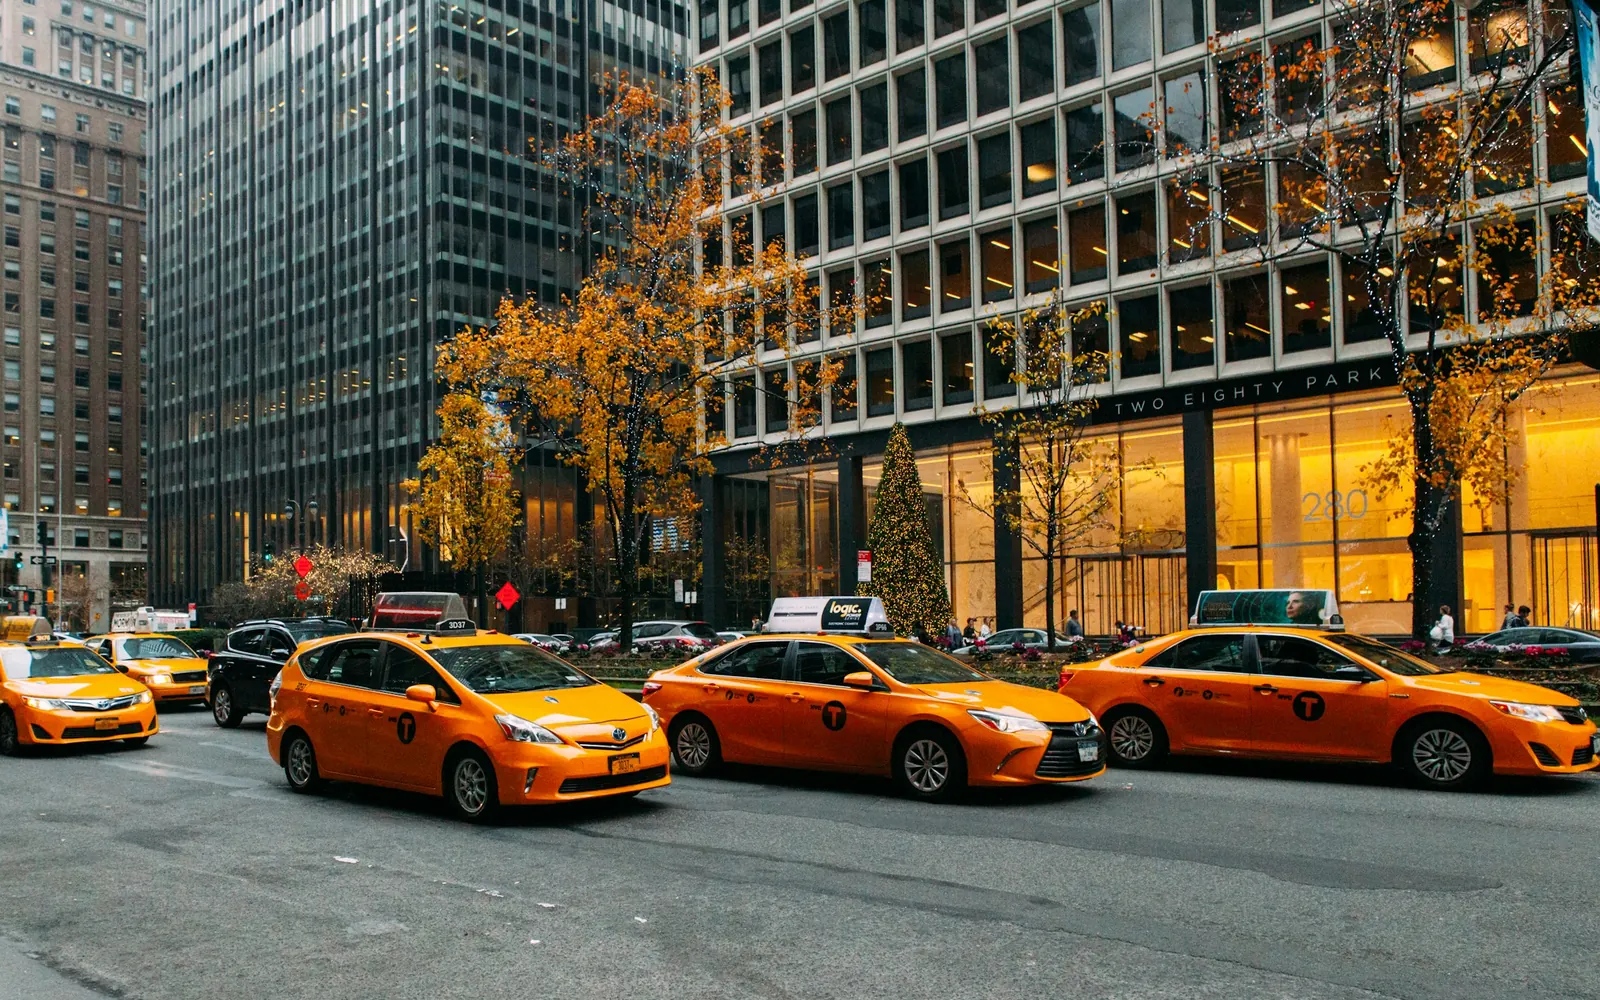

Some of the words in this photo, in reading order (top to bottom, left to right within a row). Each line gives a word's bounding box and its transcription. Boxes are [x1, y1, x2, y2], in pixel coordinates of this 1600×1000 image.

[1115, 398, 1164, 415] TWO
[1184, 380, 1283, 406] EIGHTY
[1306, 367, 1381, 389] PARK
[1302, 488, 1368, 521] 280
[449, 621, 466, 629] 3D37
[828, 705, 841, 727] T
[1301, 697, 1318, 718] T
[401, 718, 412, 740] T
